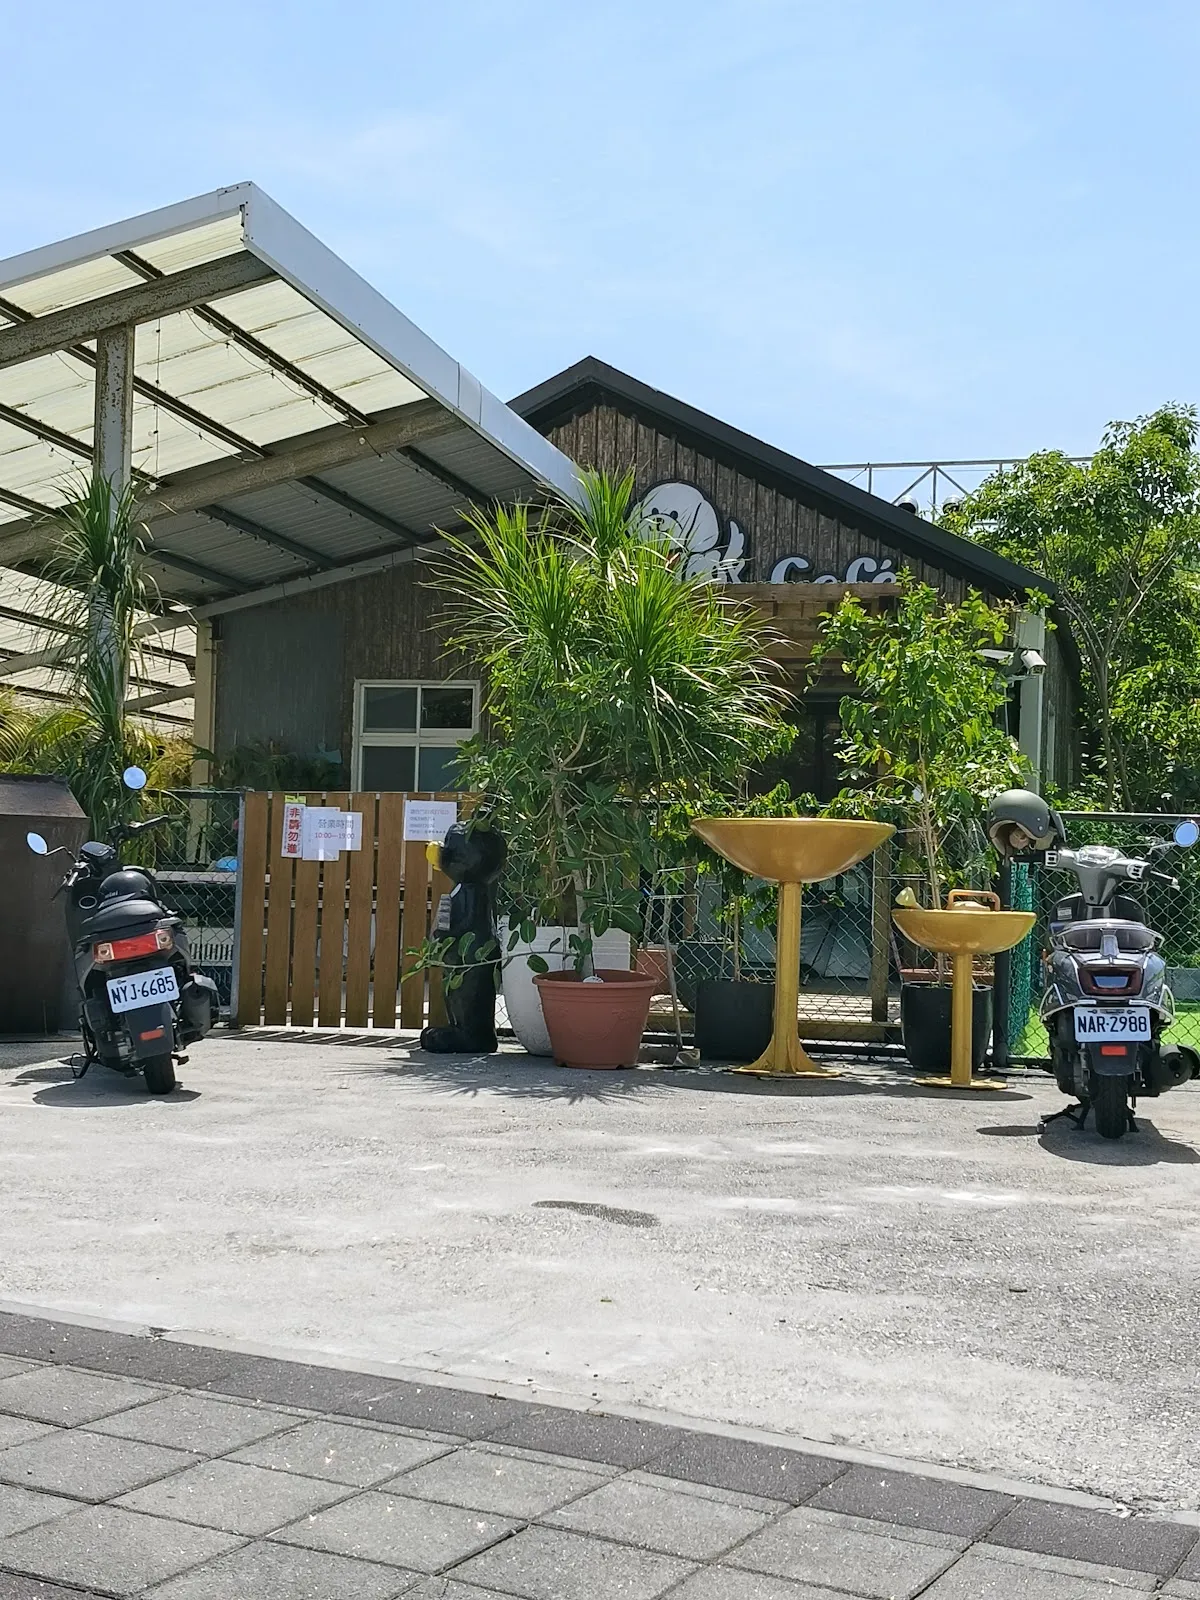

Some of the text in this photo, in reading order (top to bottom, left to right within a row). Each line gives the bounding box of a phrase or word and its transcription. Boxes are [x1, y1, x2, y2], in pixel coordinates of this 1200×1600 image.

[286, 807, 302, 854] 非請勿進
[111, 975, 175, 1005] NYJ-6685
[1077, 1015, 1148, 1034] NAR-2988
